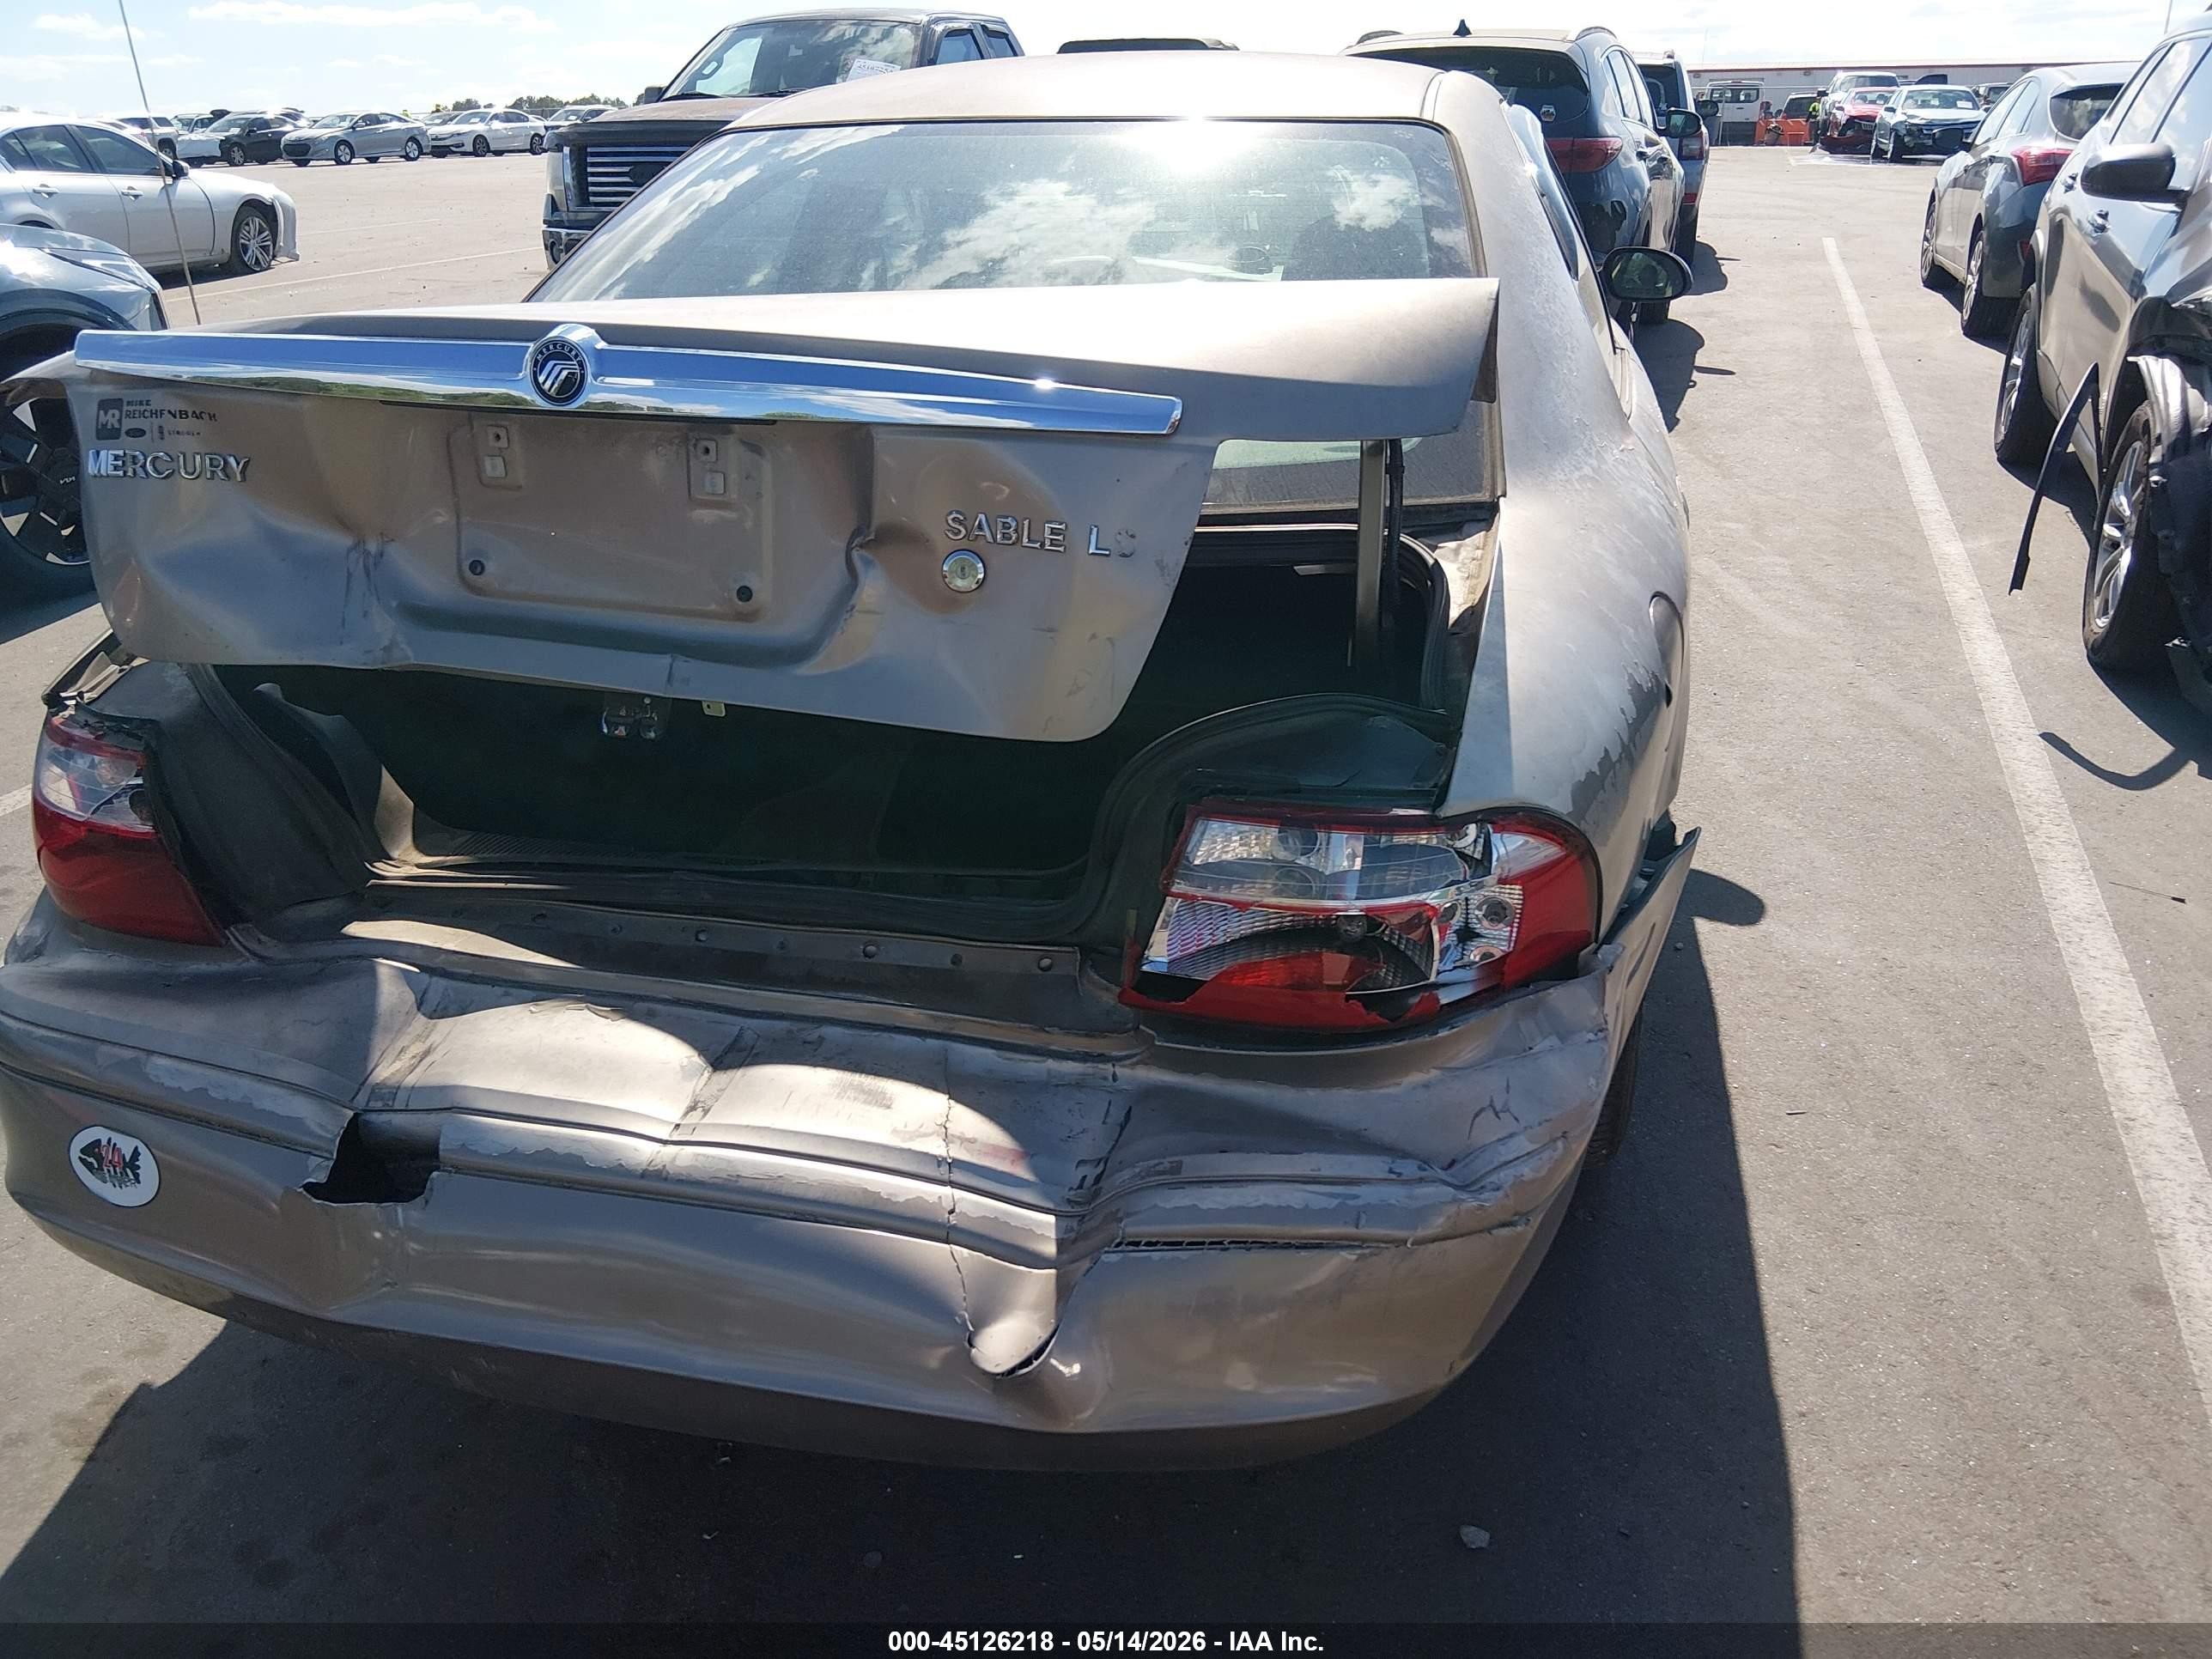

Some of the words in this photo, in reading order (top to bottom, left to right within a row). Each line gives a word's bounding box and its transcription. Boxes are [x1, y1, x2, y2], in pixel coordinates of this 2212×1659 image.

[536, 343, 583, 362] MERCURY
[88, 449, 251, 483] MERCURY
[945, 510, 1068, 554] SABLE
